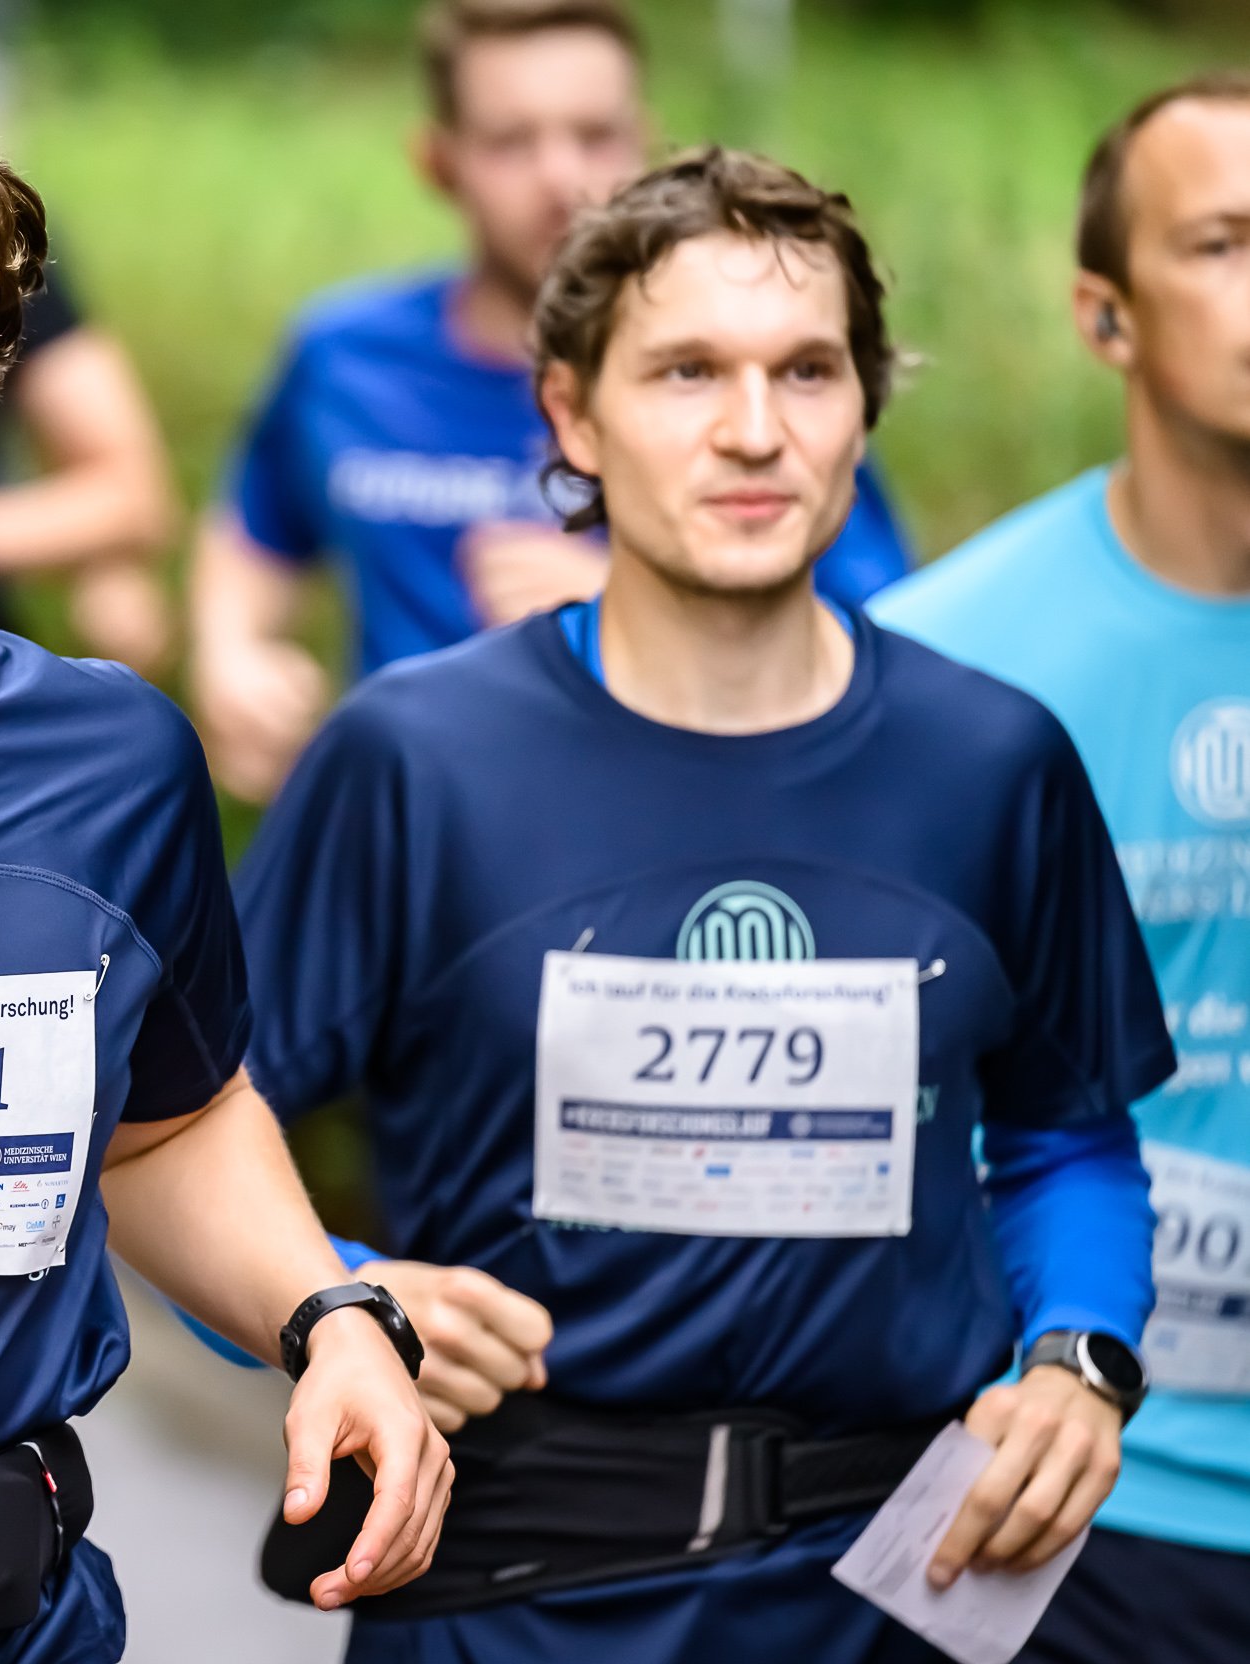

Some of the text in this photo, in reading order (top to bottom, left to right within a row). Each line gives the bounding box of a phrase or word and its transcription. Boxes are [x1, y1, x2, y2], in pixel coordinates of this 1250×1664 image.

[633, 1025, 825, 1086] 2779
[4, 1145, 54, 1155] MEDIZINISCHE
[3, 1153, 67, 1164] UNIVERSITÄT WIEN
